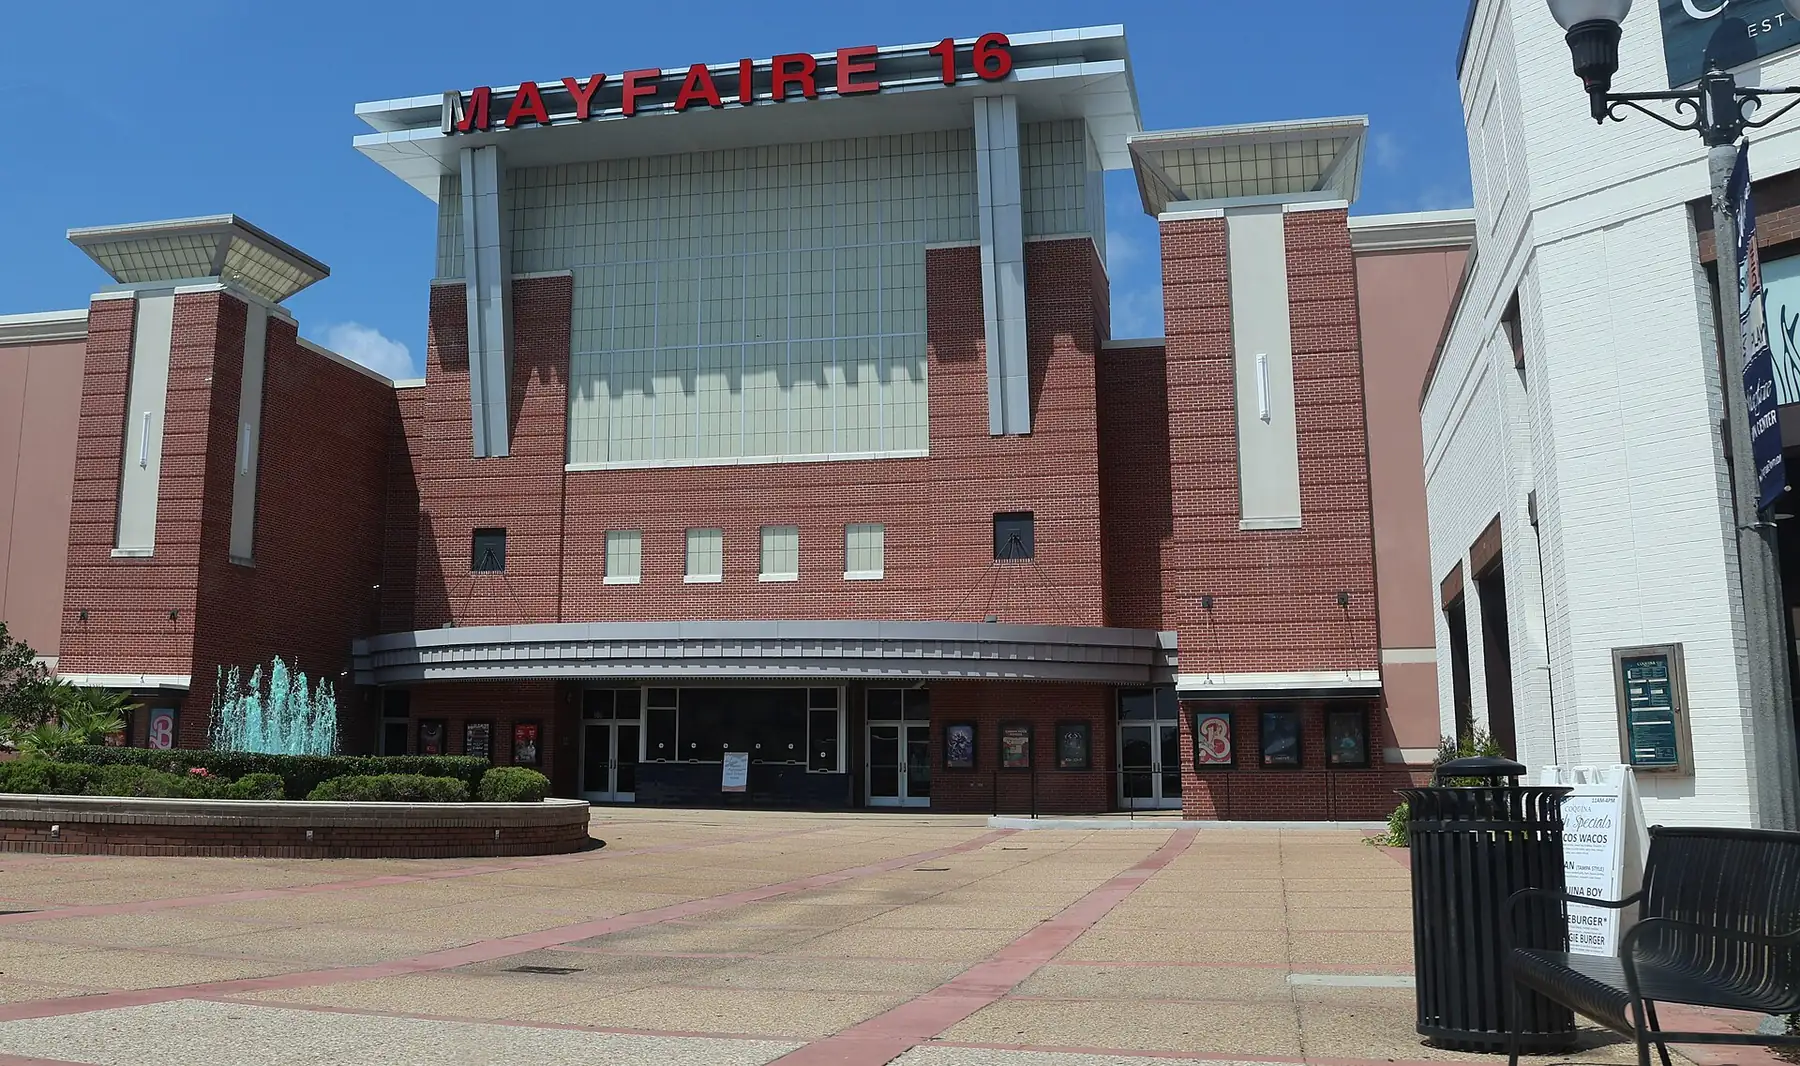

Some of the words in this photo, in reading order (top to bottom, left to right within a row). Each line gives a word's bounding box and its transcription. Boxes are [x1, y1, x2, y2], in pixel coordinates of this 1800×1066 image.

[1747, 12, 1785, 38] EST
[441, 45, 881, 136] MAYFAIRE
[928, 31, 1013, 86] 16
[1756, 409, 1777, 435] CENTER
[1564, 805, 1592, 813] COQUINA
[1573, 814, 1612, 832] Specials
[1579, 833, 1608, 844] WACOS
[1586, 887, 1603, 897] BOY
[1580, 934, 1605, 945] BURGER
